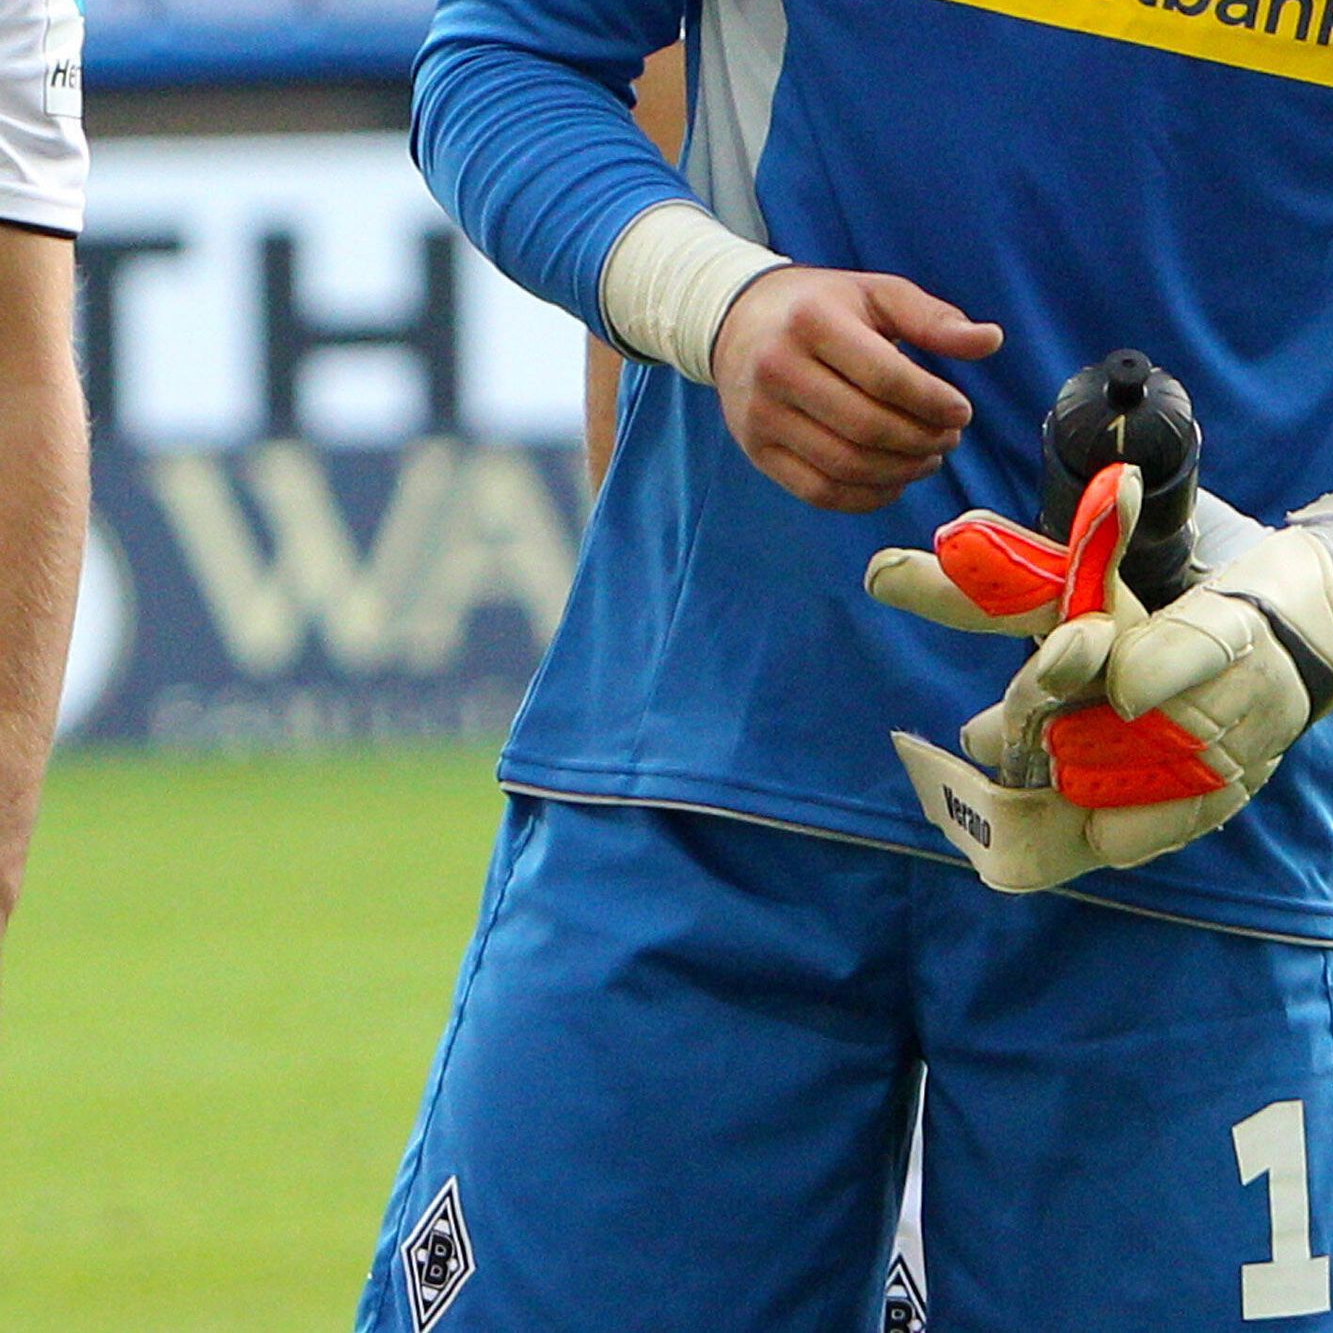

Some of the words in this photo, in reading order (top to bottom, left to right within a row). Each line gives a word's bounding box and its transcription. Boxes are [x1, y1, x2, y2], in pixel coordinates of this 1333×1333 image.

[1107, 414, 1126, 455] 1
[943, 783, 991, 849] Verano
[1232, 1100, 1331, 1320] 1
